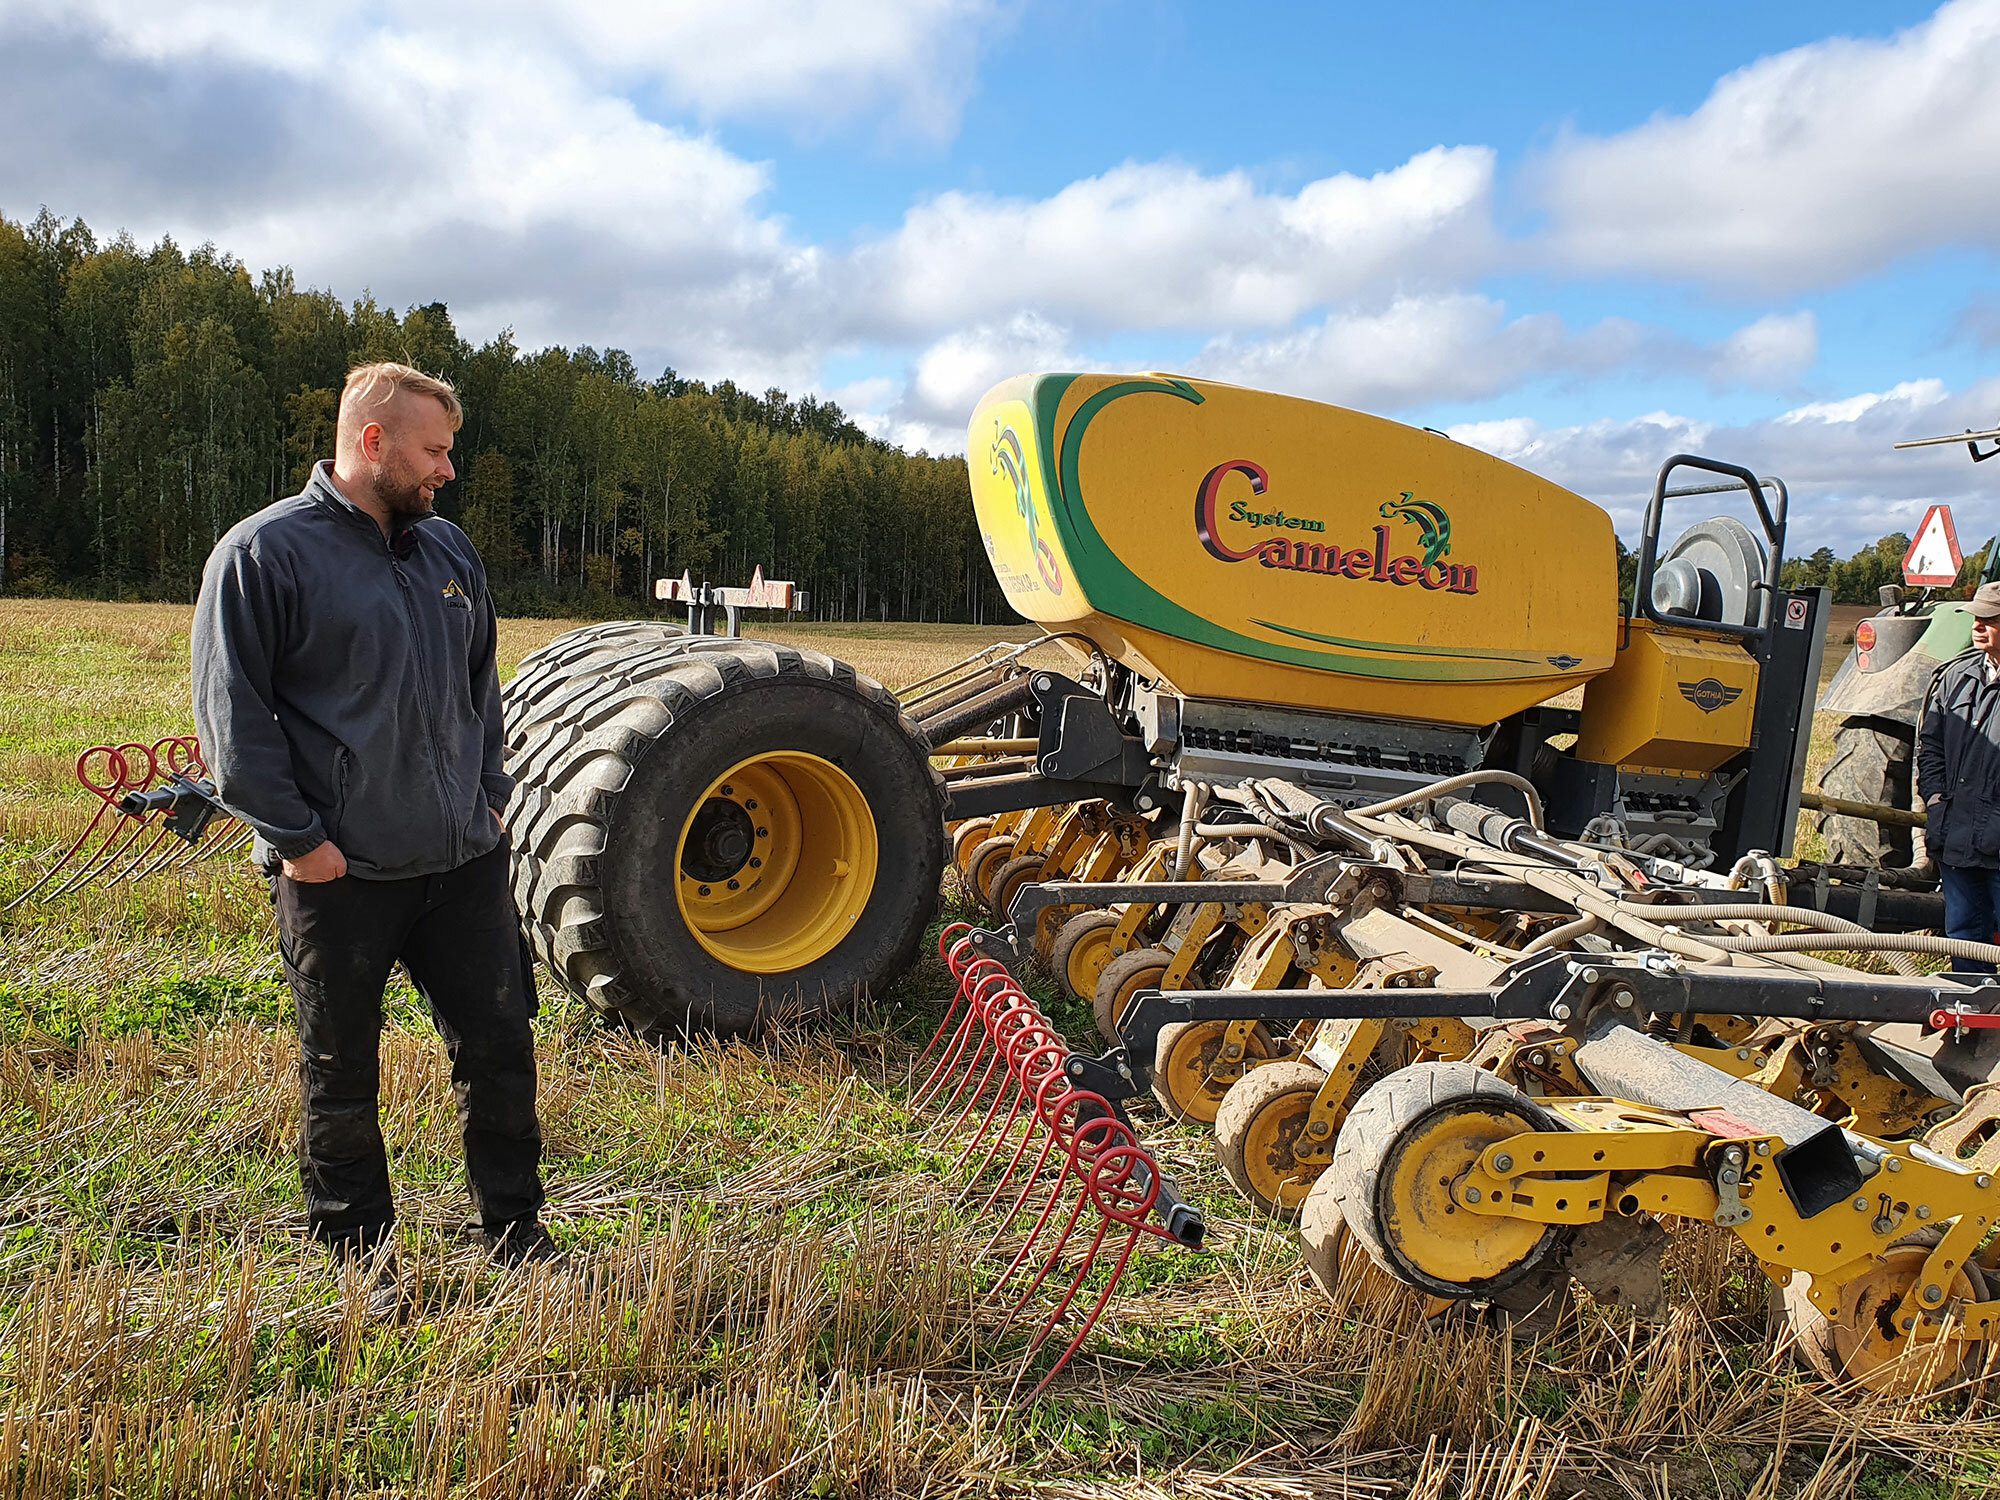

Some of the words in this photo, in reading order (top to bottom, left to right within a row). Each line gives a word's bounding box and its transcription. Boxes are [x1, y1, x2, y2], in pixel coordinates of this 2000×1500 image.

[1194, 458, 1479, 596] Cameleon
[1228, 500, 1326, 533] System
[1695, 688, 1722, 700] GOTHIA
